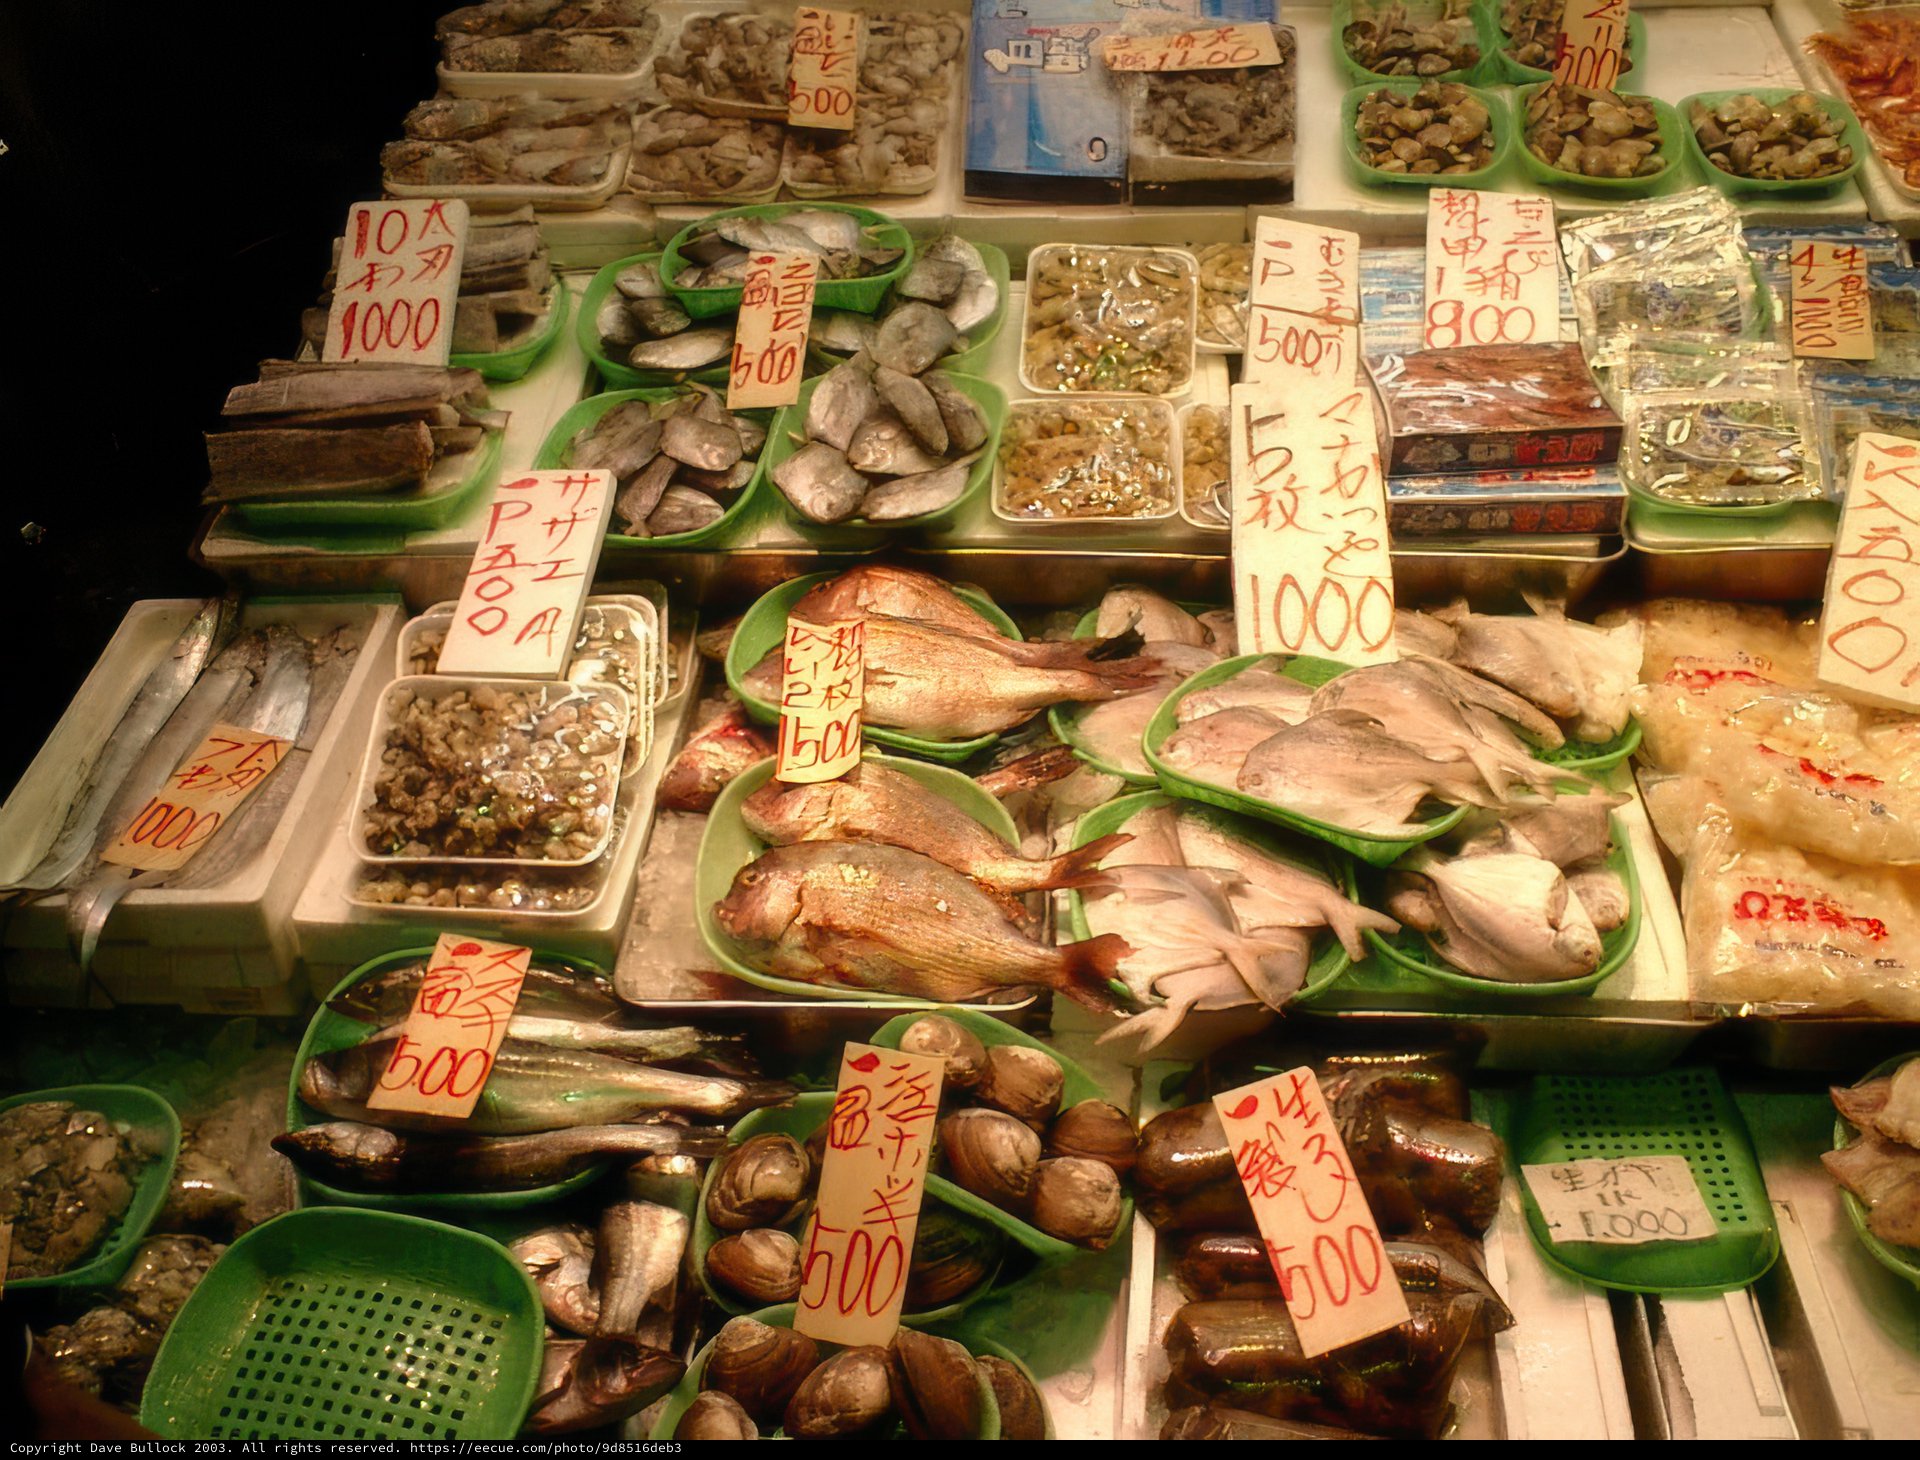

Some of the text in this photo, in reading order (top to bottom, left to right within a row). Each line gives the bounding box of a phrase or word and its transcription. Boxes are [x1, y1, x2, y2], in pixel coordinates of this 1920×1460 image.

[786, 80, 853, 116] 500
[341, 298, 441, 359] 1000
[1254, 314, 1322, 369] 500
[1424, 300, 1536, 350] 800
[733, 338, 797, 390] 500
[1250, 573, 1397, 653] 1000
[776, 709, 863, 775] 1500
[125, 796, 221, 850] 1000
[380, 1034, 491, 1098] 500
[800, 1207, 905, 1317] 500
[1264, 1224, 1382, 1320] 500
